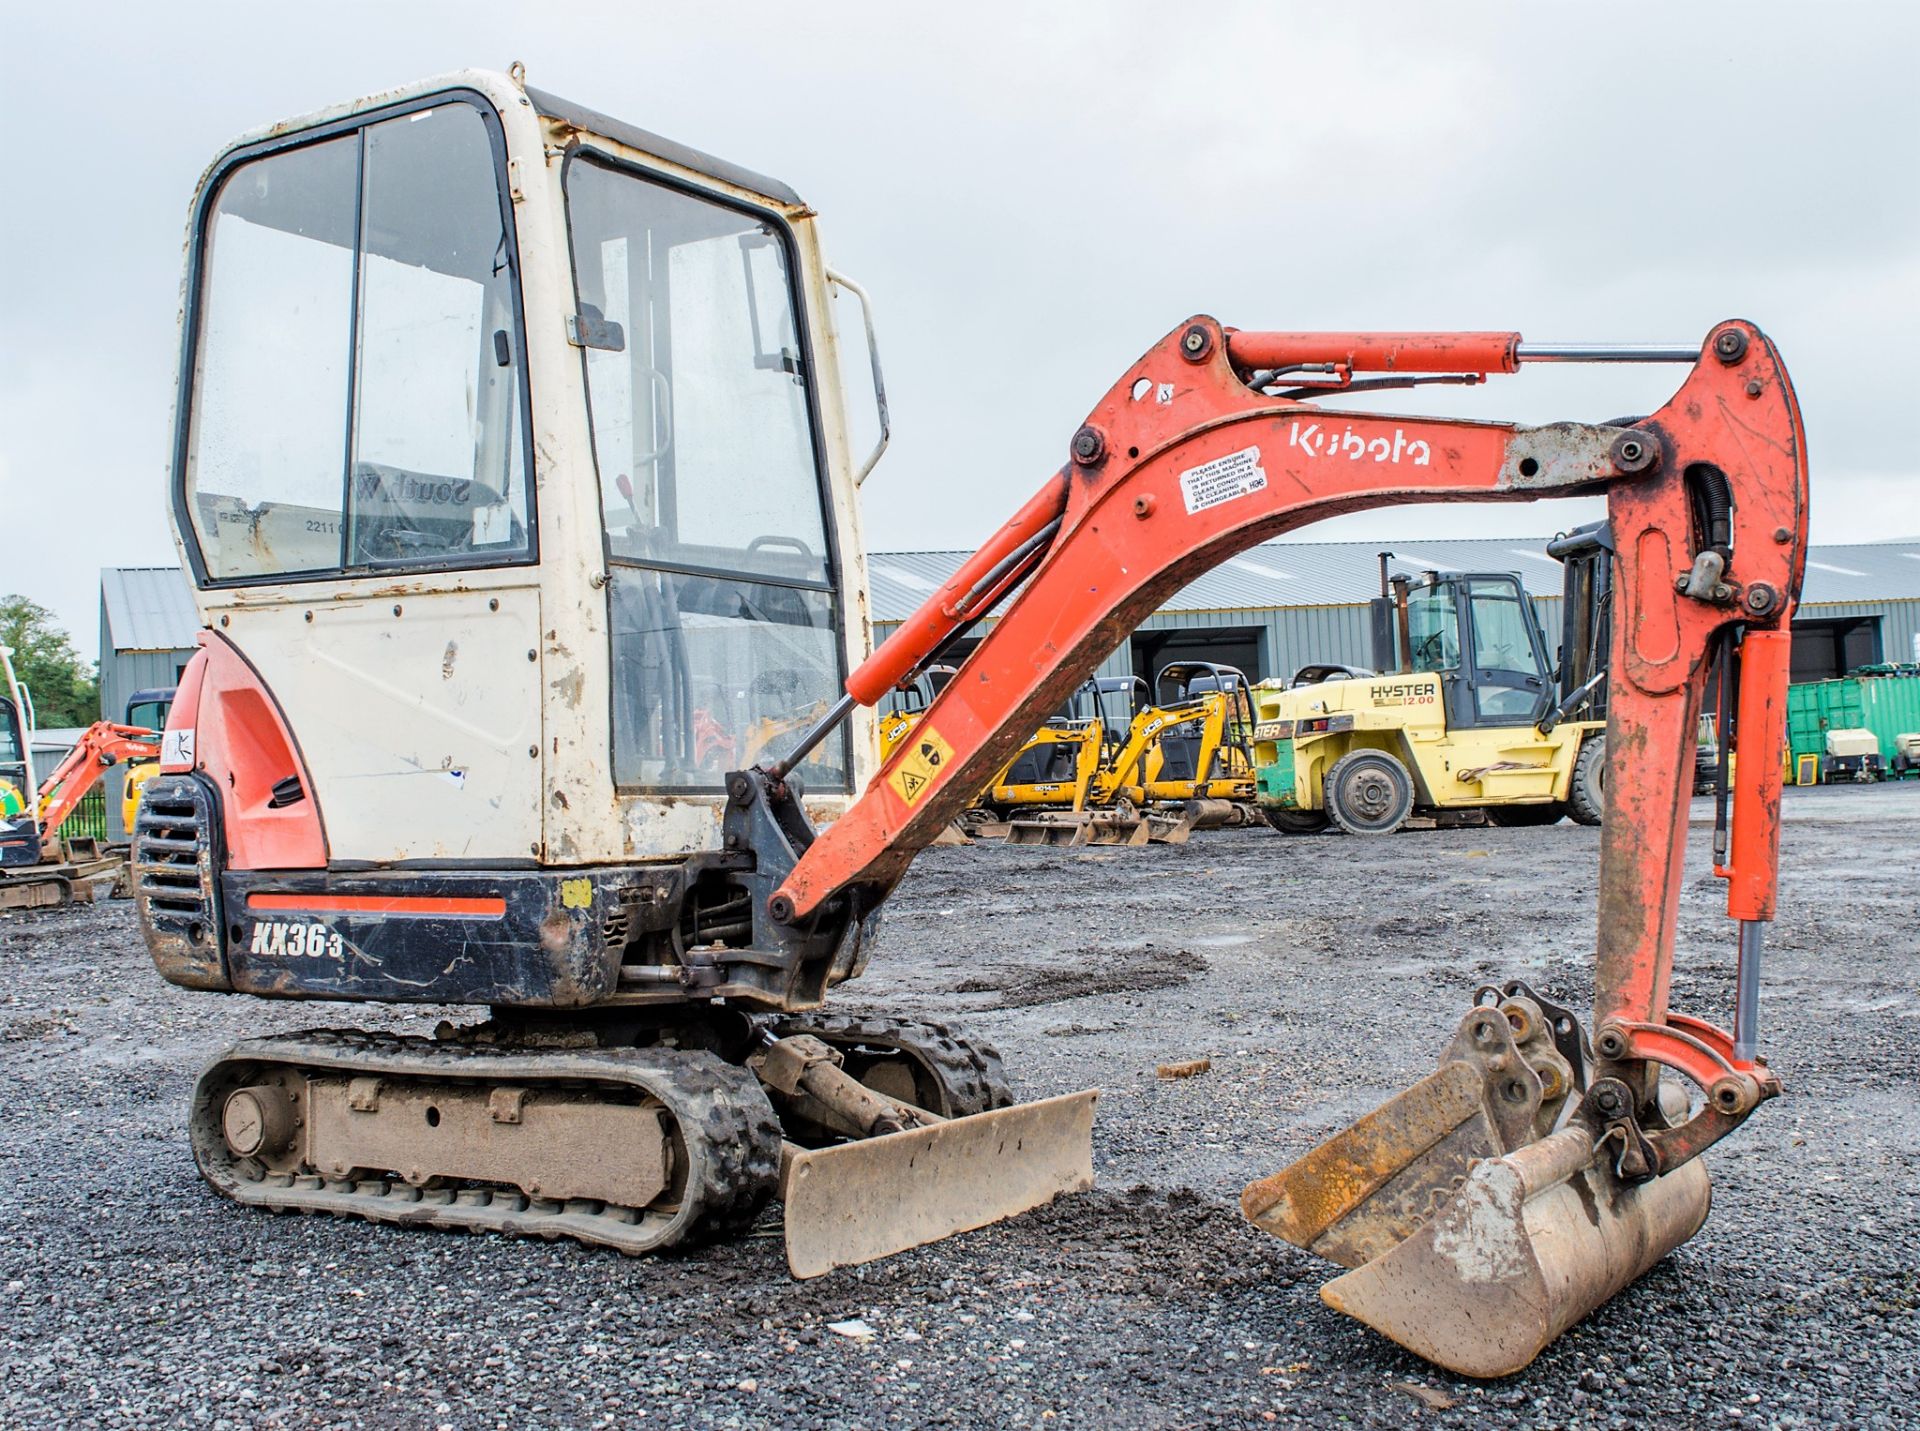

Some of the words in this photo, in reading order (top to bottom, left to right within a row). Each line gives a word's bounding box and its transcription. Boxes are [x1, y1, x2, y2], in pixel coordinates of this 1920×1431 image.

[1290, 422, 1430, 465] Kubota
[1187, 475, 1203, 485] THAT
[1205, 469, 1220, 479] THIS
[1222, 457, 1252, 472] MACHINE
[1191, 463, 1217, 477] PLEASE
[1218, 453, 1245, 467] ENSURE
[1192, 485, 1215, 497] CLEAN
[1216, 471, 1254, 489] CONDITION
[1200, 471, 1236, 487] RETURNED
[1205, 483, 1239, 499] CLEANING
[306, 520, 334, 534] 2211
[1370, 684, 1435, 699] HYSTER
[887, 721, 907, 742] JCB
[1142, 718, 1163, 737] JCB
[250, 922, 343, 958] KX36-3
